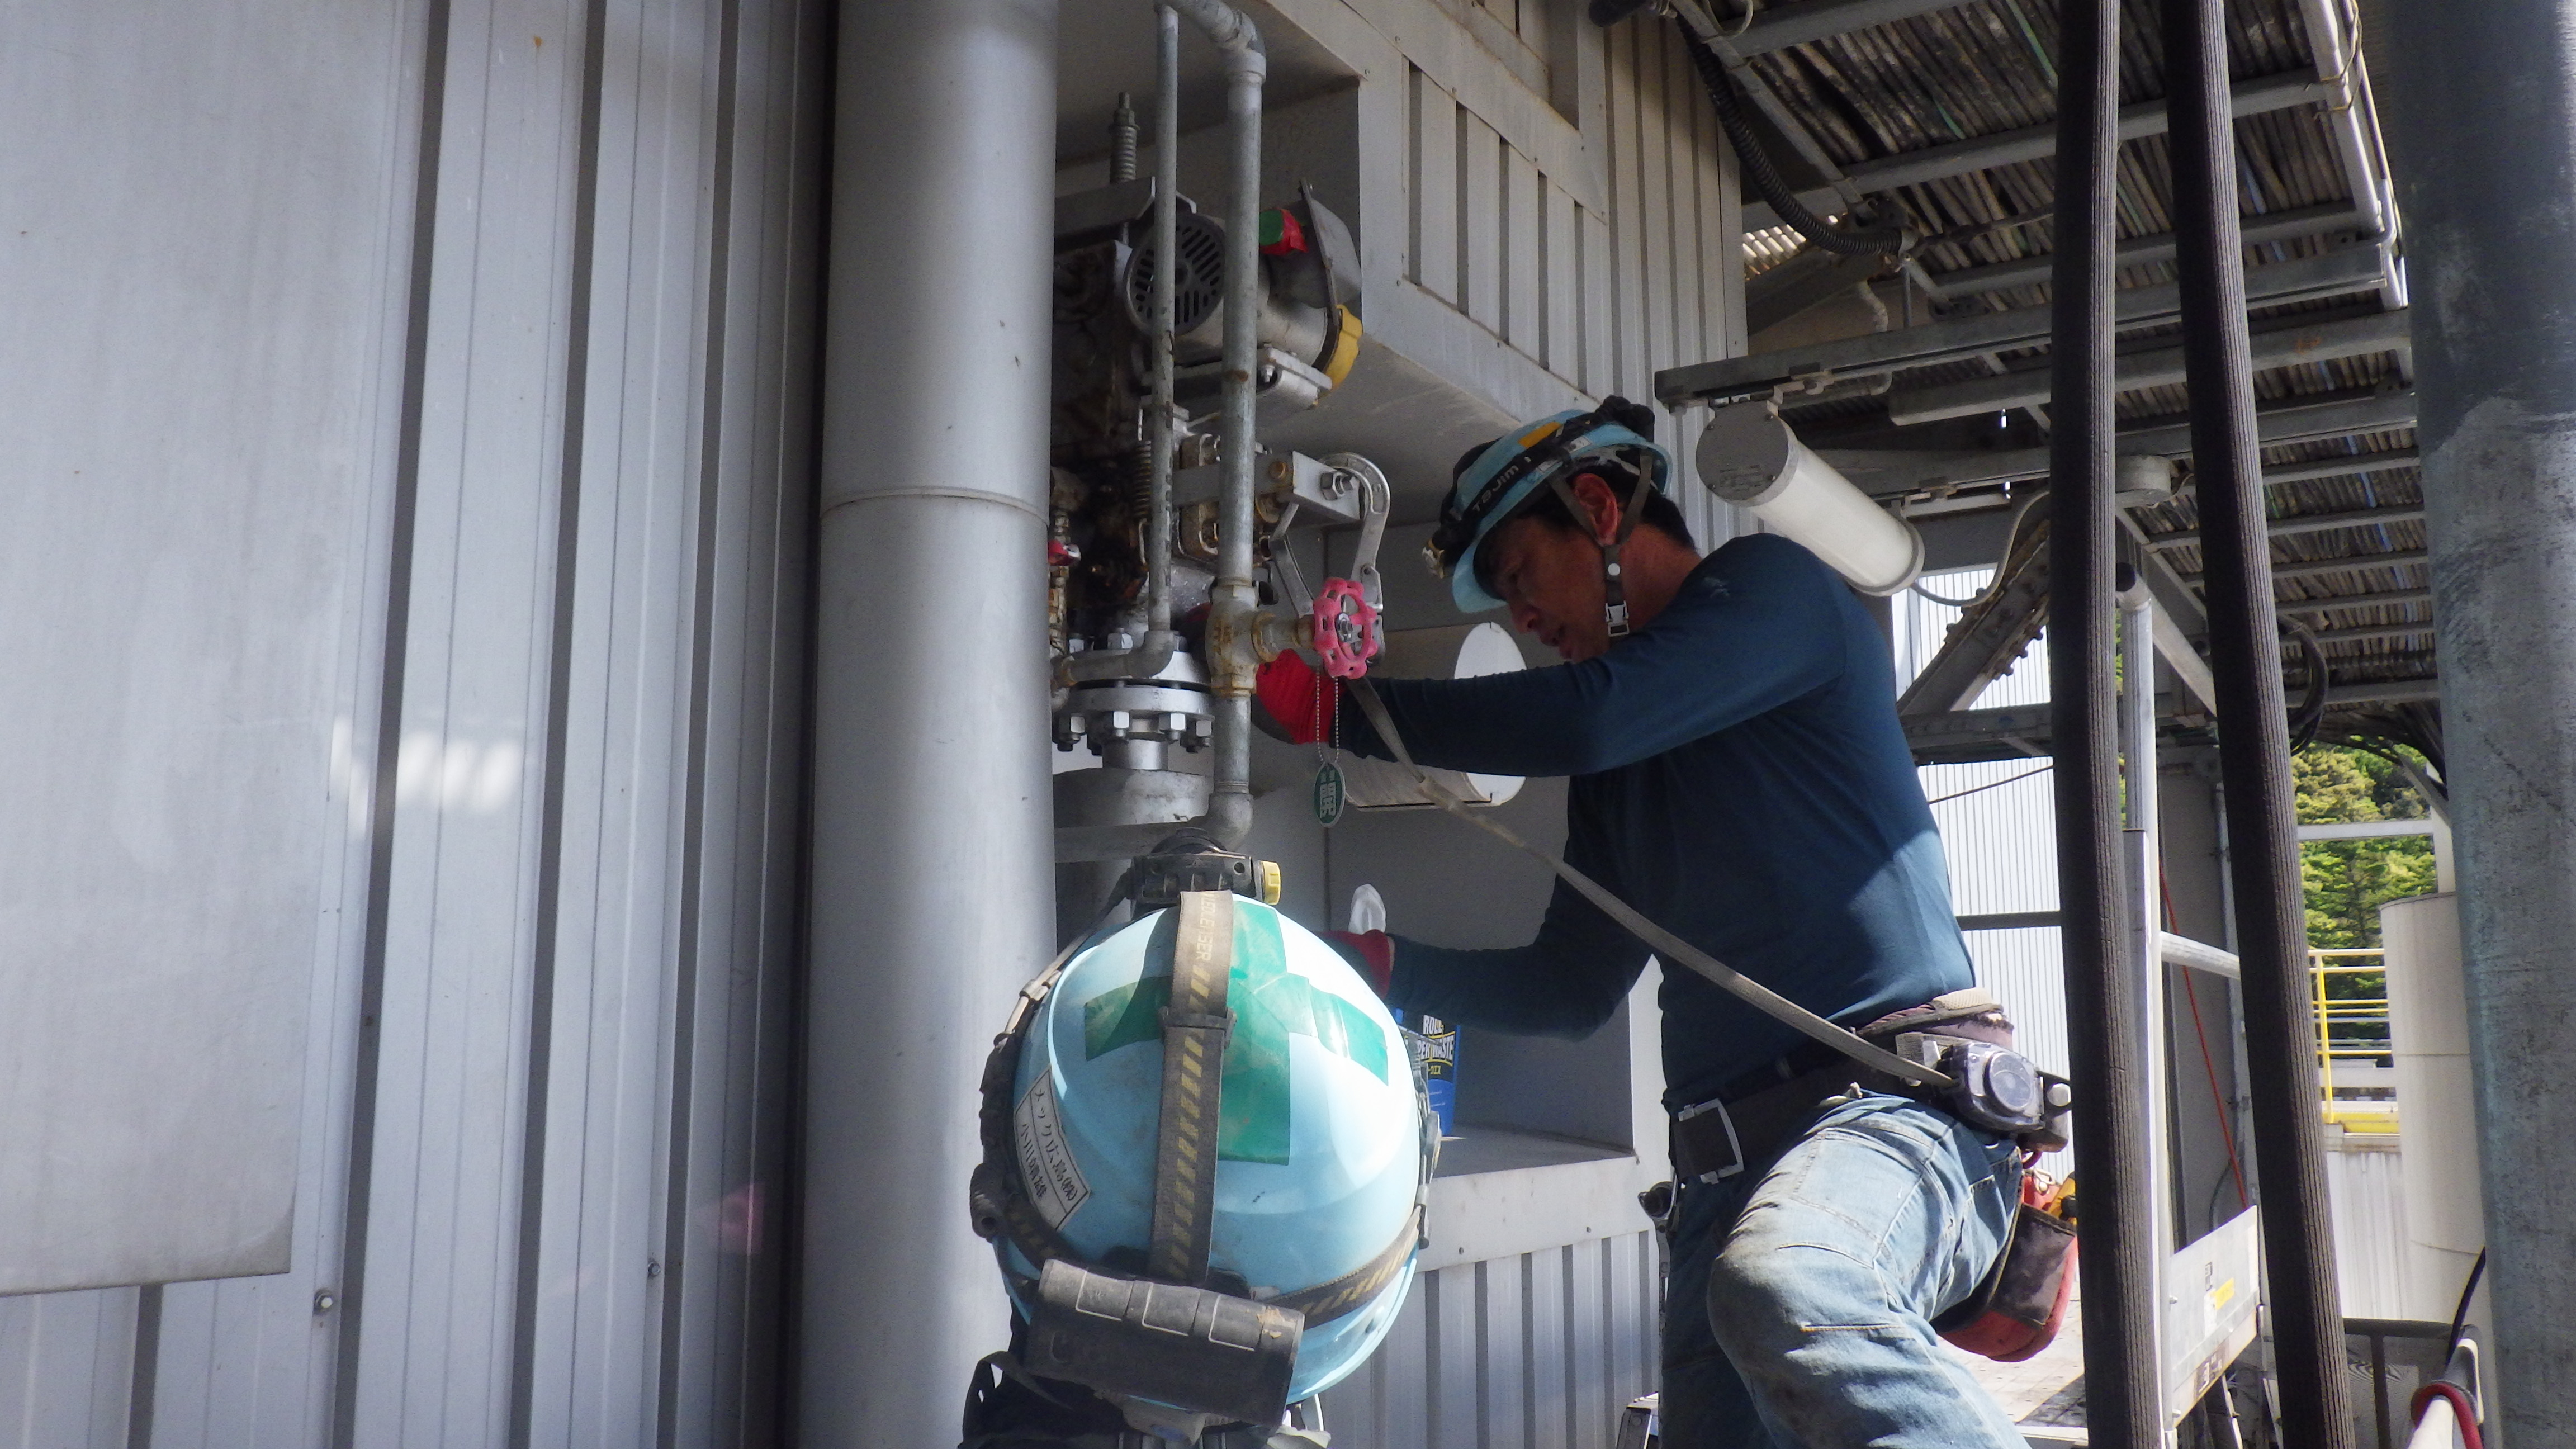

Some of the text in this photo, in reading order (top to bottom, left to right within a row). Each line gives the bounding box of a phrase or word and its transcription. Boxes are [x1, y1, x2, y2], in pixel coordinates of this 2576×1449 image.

[1423, 1015, 1443, 1035] ROLL
[1417, 1034, 1455, 1061] PER WASTE
